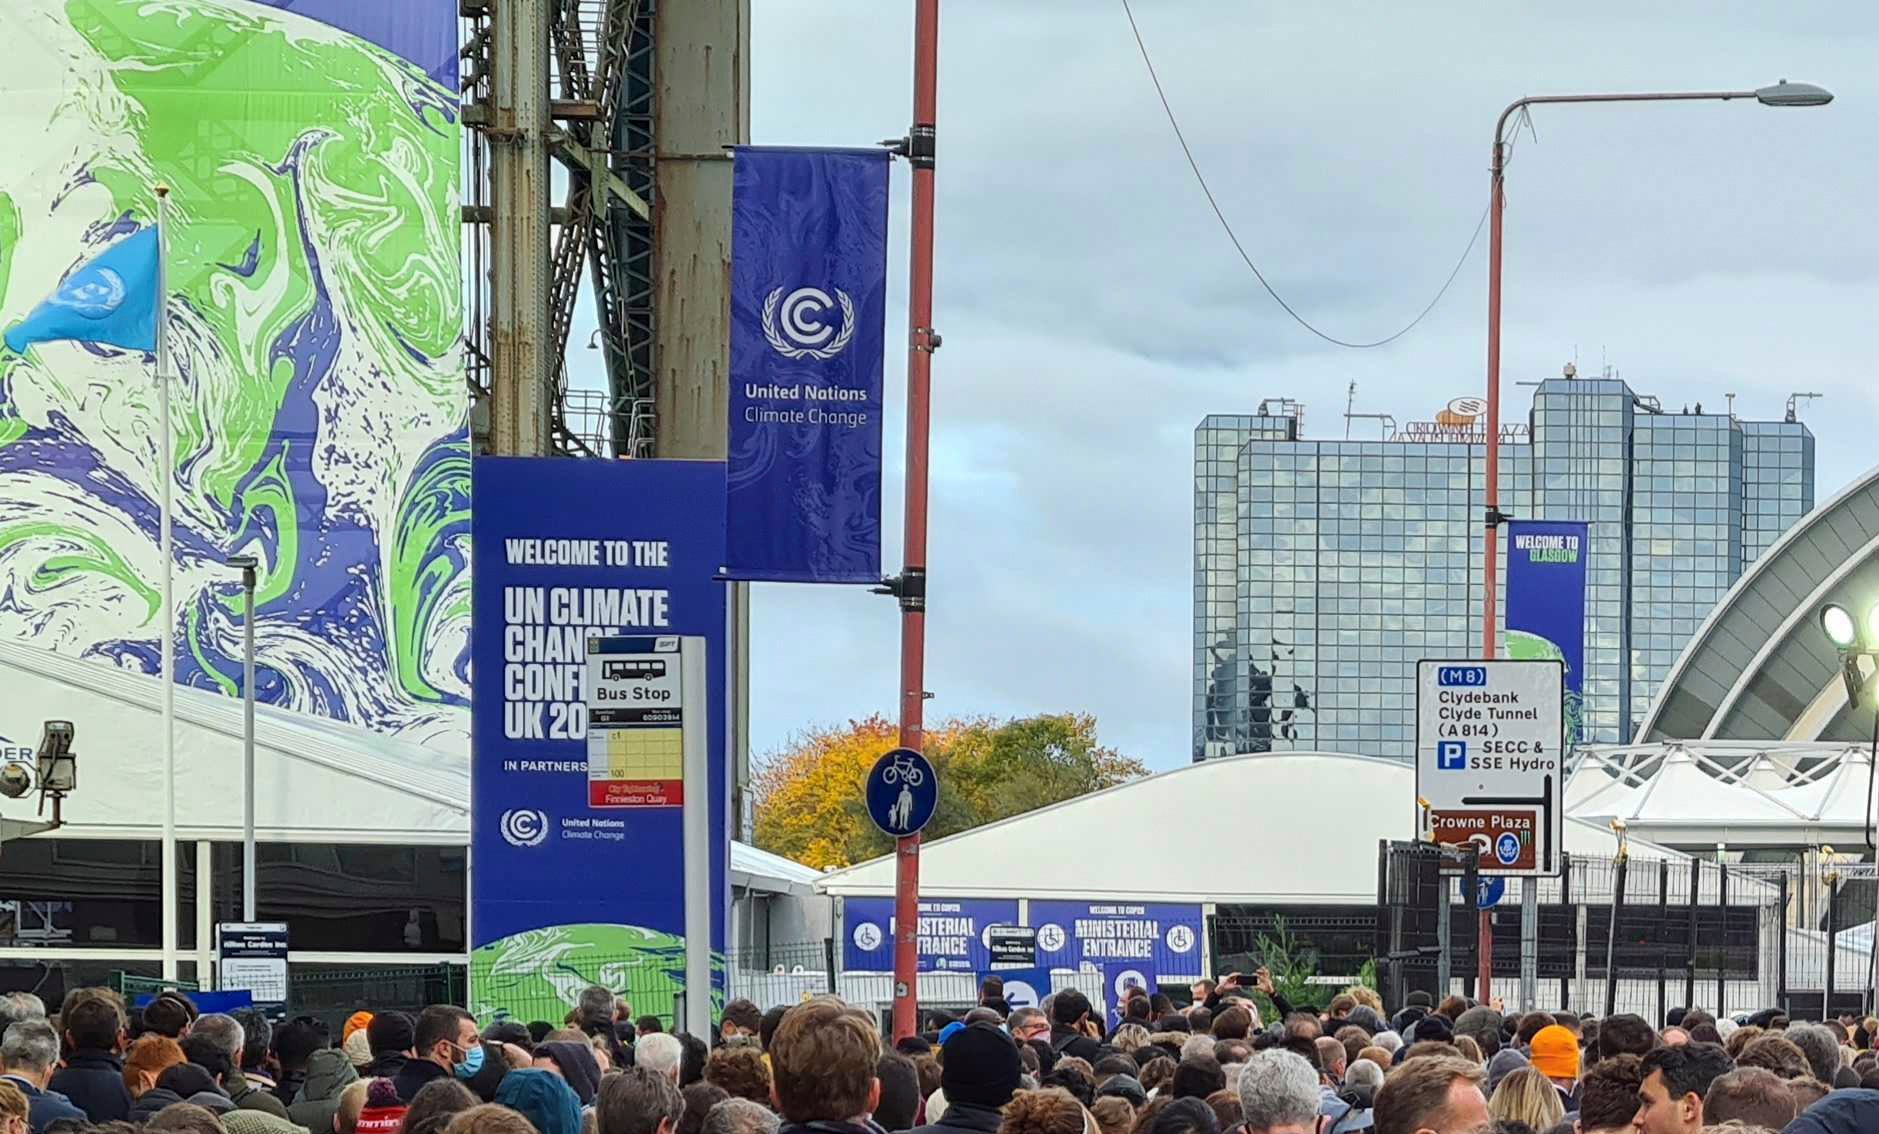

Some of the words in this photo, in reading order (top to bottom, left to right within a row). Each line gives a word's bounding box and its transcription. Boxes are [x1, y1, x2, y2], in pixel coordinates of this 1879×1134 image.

[745, 383, 799, 399] United
[804, 385, 867, 401] Nations
[745, 406, 804, 423] Climate
[808, 408, 867, 428] Change
[1515, 535, 1563, 549] WELCOME
[1565, 535, 1579, 549] TO
[505, 538, 599, 565] WELCOME
[603, 540, 628, 566] TO
[632, 541, 669, 567] THE
[1530, 549, 1577, 563] GLASGOW
[504, 587, 544, 625] UN
[550, 587, 669, 627] CLIMATE
[504, 625, 619, 663] CHAN
[597, 687, 627, 700] Bus
[632, 687, 671, 702] Stop
[1438, 691, 1519, 705] Clydebank
[504, 702, 544, 740] UK
[1438, 707, 1481, 721] Clyde
[1487, 707, 1538, 720] Tunnel
[1482, 741, 1528, 754] SECC
[1533, 741, 1543, 754] &
[1444, 744, 1462, 768] P
[504, 760, 517, 771] IN
[1470, 757, 1503, 769] SSE
[1510, 757, 1555, 772] Hydro
[646, 794, 667, 805] Quay
[562, 818, 590, 828] United
[592, 819, 624, 828] Nations
[1430, 815, 1485, 829] Crowne
[1491, 815, 1531, 829] Plaza
[562, 831, 592, 839] Climate
[594, 831, 625, 841] Change
[1075, 919, 1160, 939] MINISTERIAL
[1082, 938, 1152, 957] ENTRANCE
